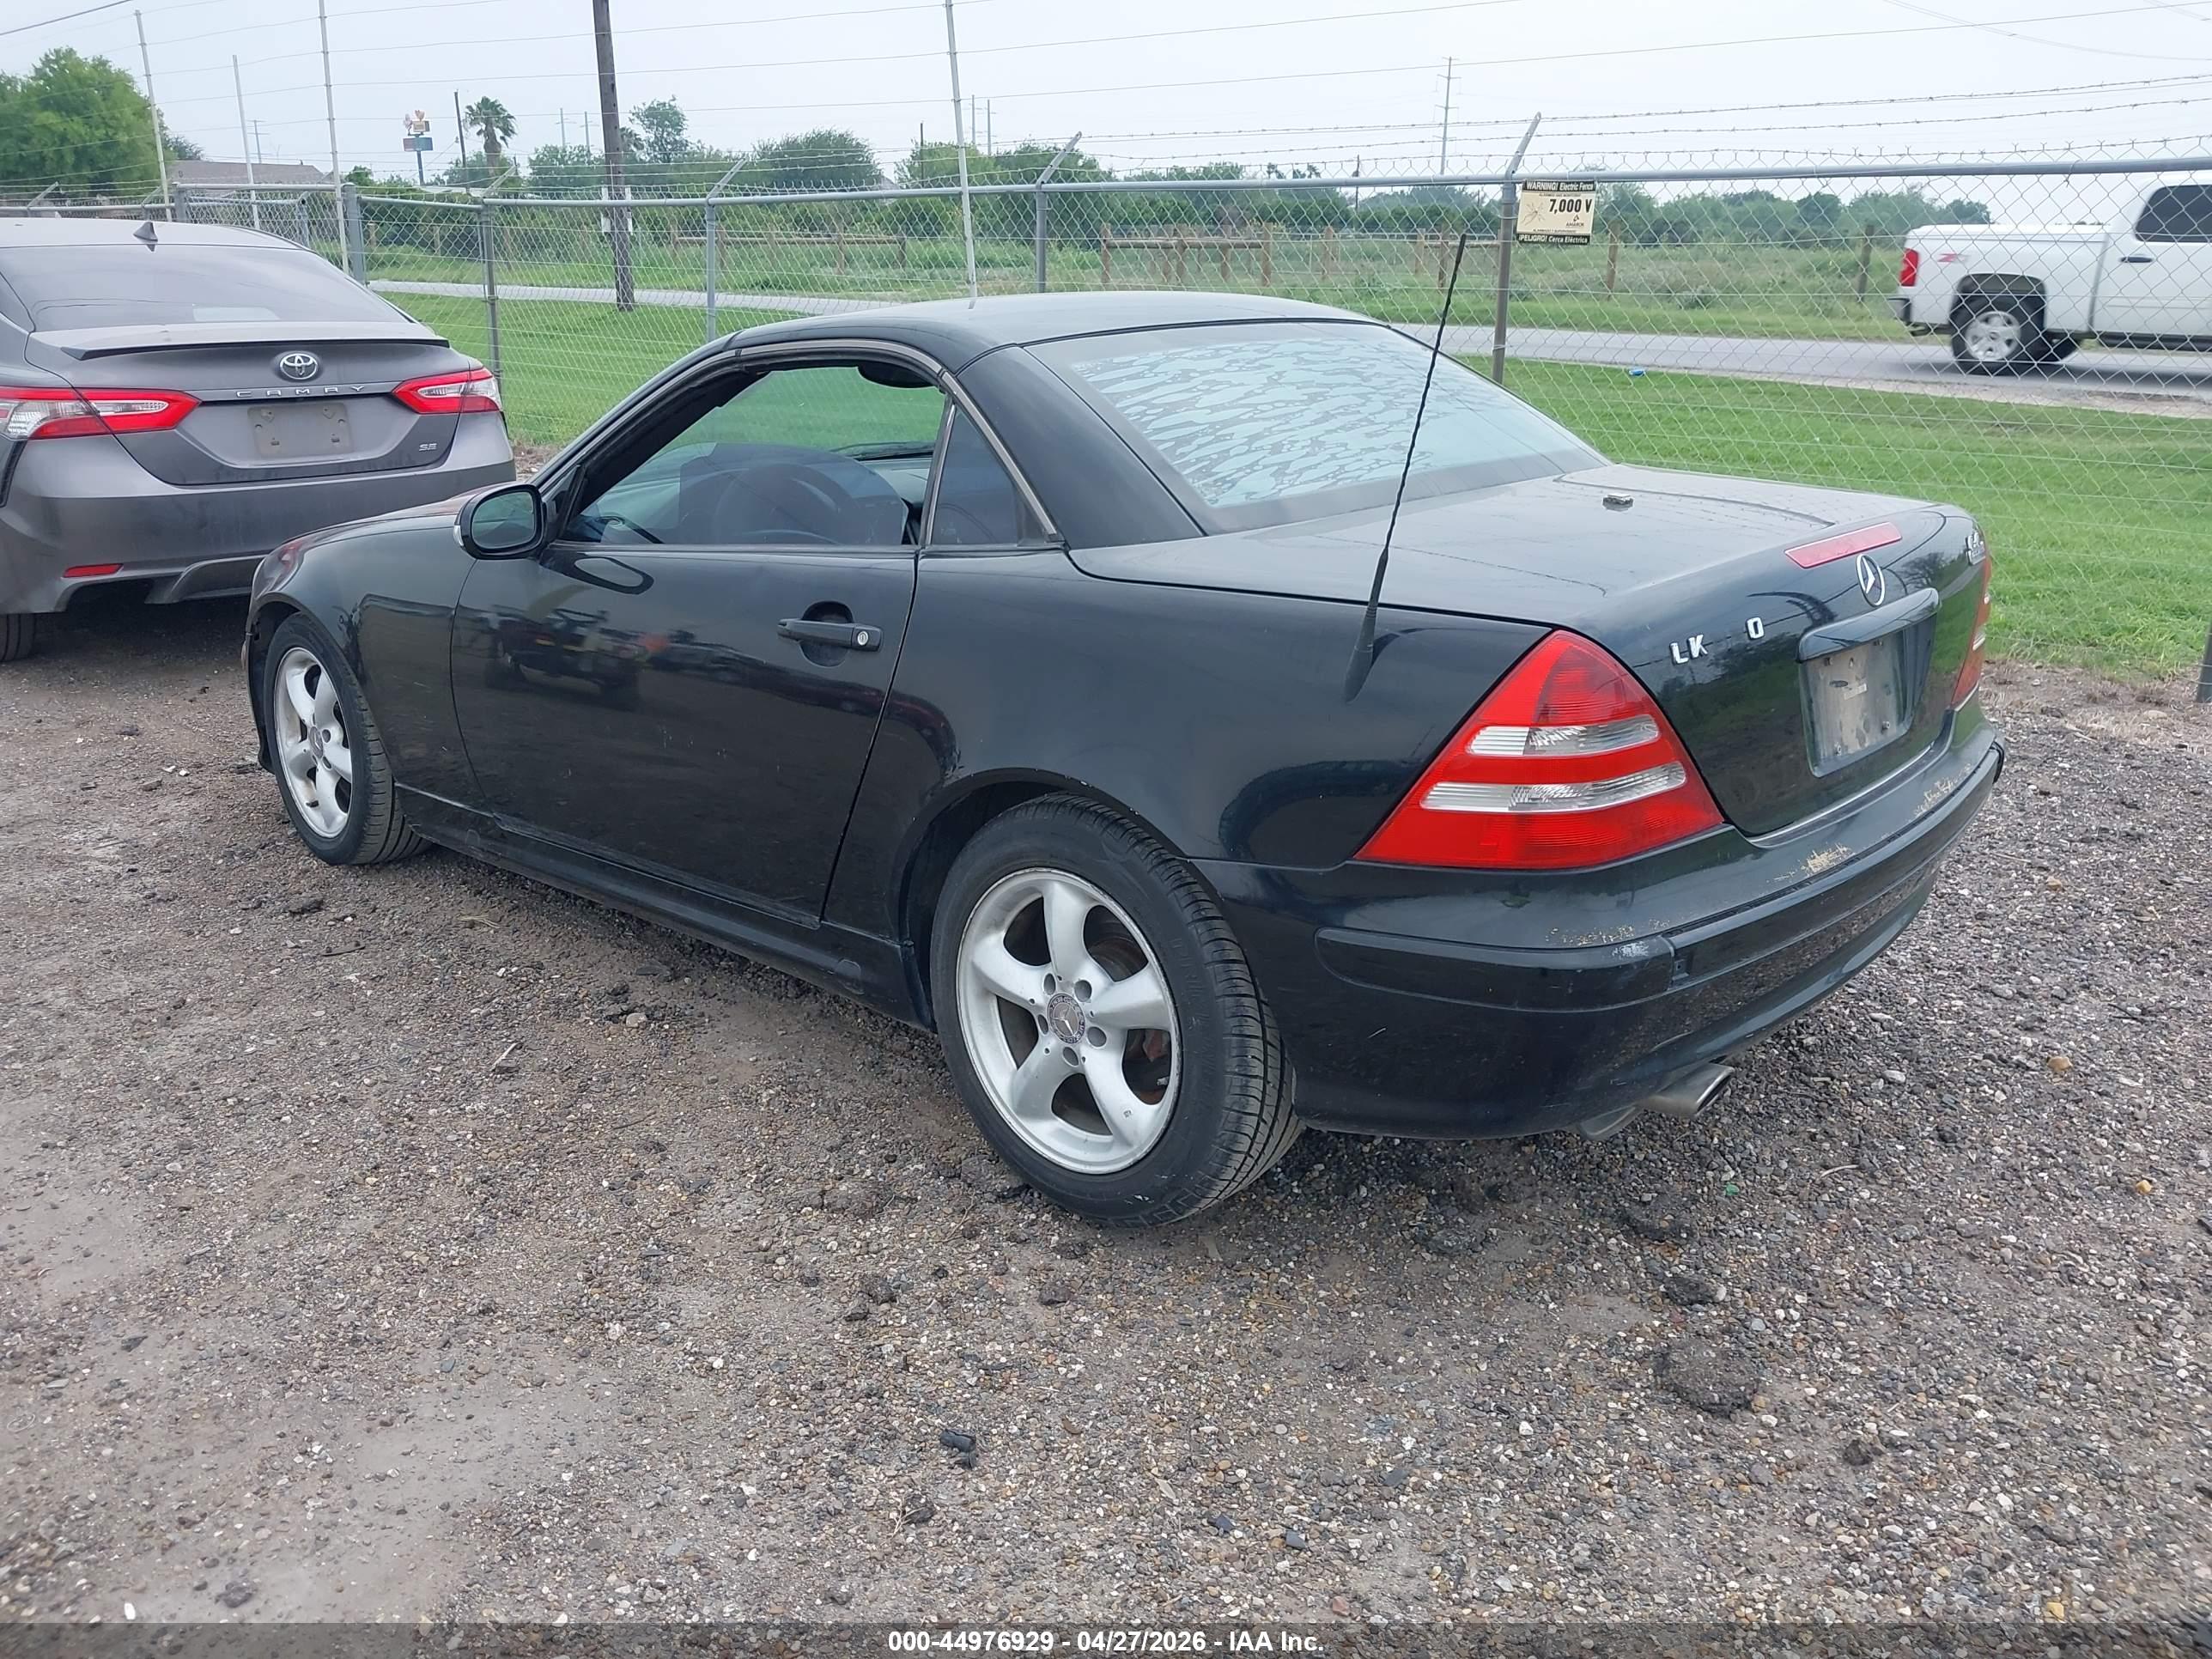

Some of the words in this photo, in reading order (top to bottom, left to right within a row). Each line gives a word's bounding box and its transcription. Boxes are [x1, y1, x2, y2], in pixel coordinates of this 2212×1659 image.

[1527, 182, 1559, 191] WARNING!
[1549, 199, 1582, 215] 7,000
[1585, 198, 1593, 213] V
[235, 385, 365, 398] CAMRY
[418, 442, 438, 452] SE
[1669, 634, 1709, 665] LK
